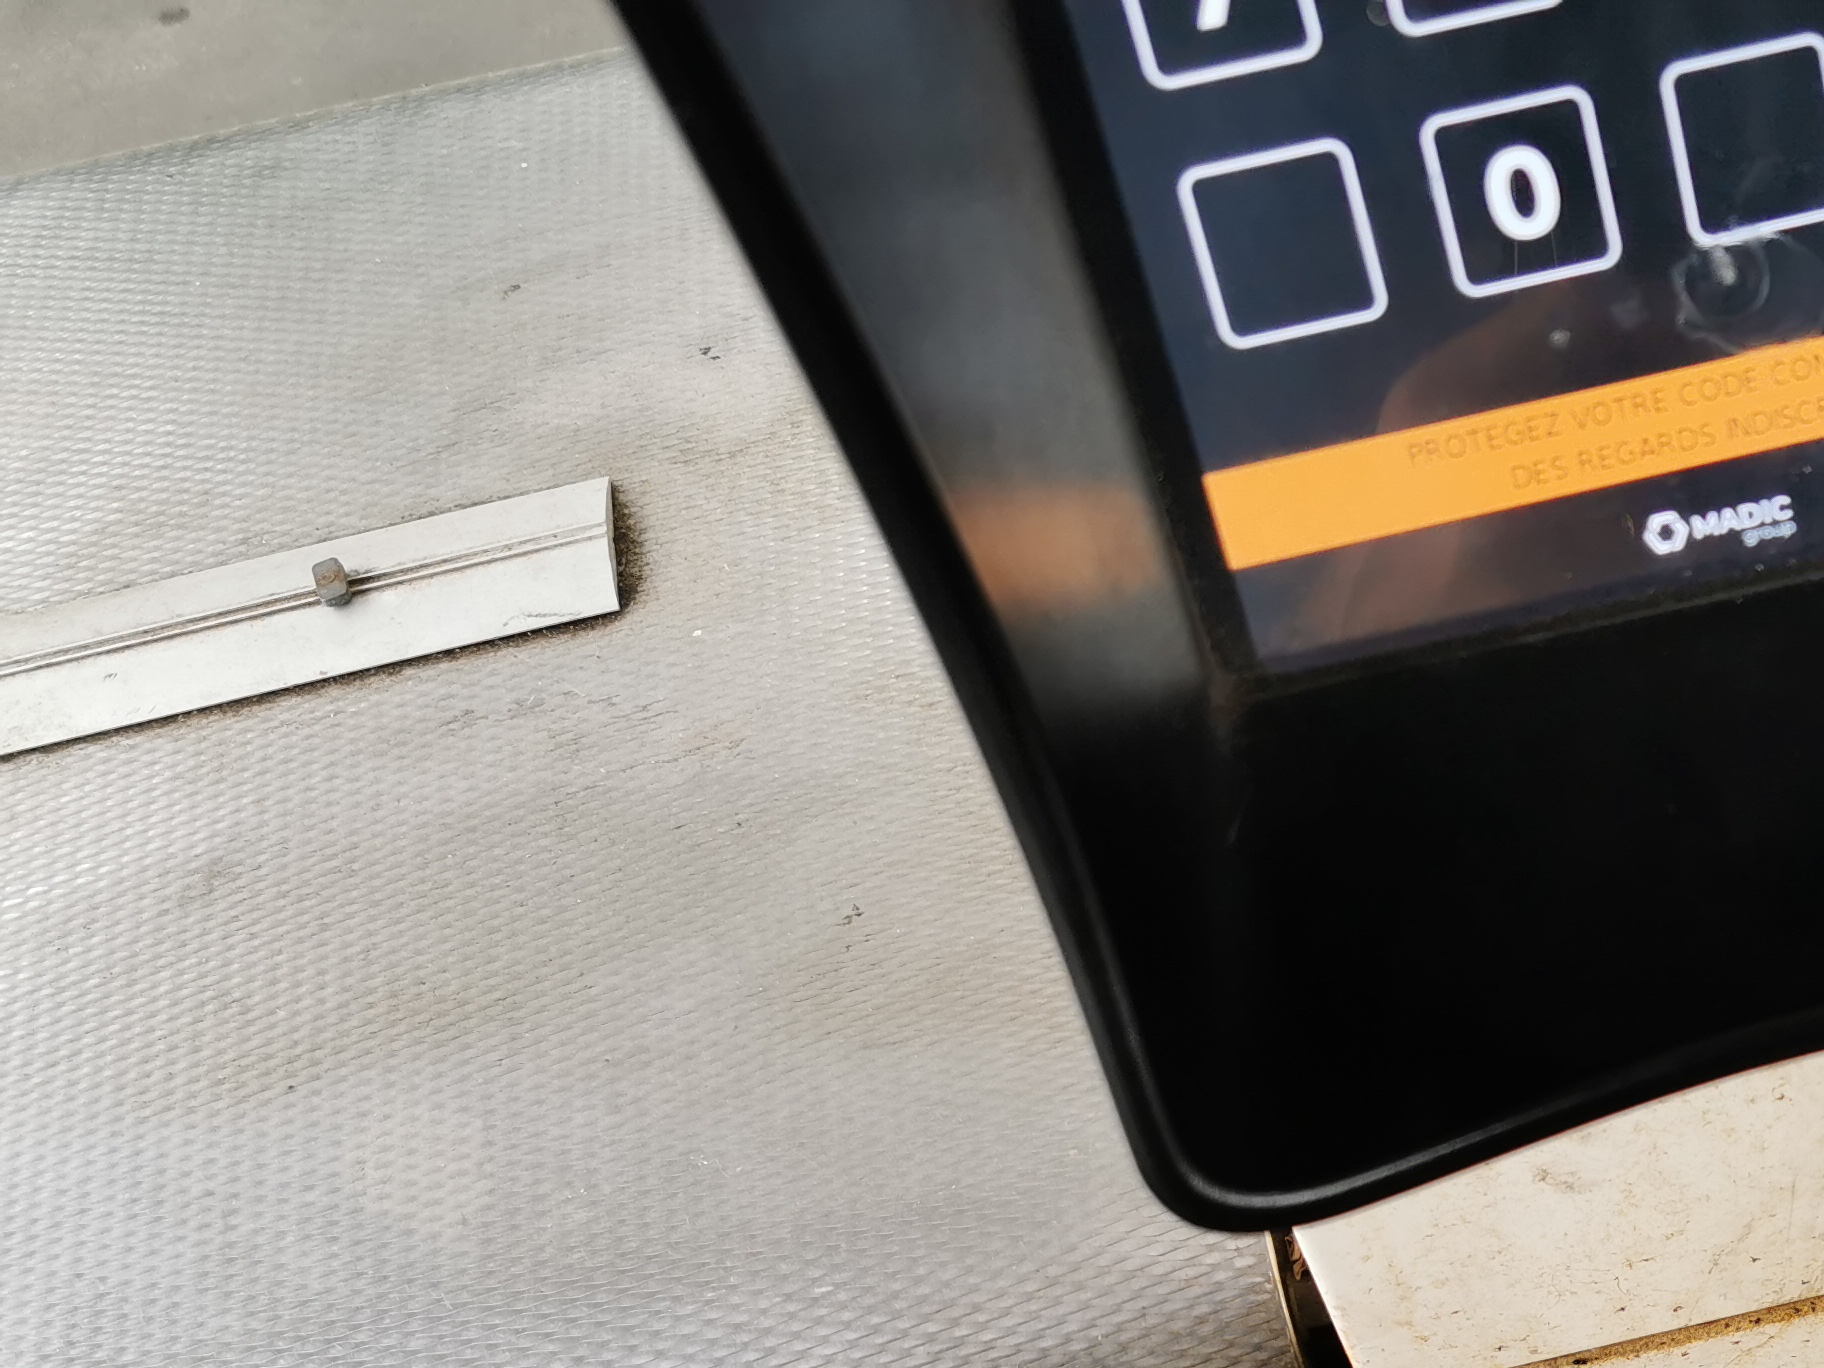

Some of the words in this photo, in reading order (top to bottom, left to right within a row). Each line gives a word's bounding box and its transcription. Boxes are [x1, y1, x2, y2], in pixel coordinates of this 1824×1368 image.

[1484, 144, 1561, 241] 0
[1408, 412, 1560, 468] PROTEGEZ
[1570, 386, 1669, 431] VOTRE
[1676, 367, 1758, 406] CODE
[1510, 459, 1569, 491] DES
[1578, 424, 1716, 472] REGARDS
[1689, 495, 1794, 540] MADIC
